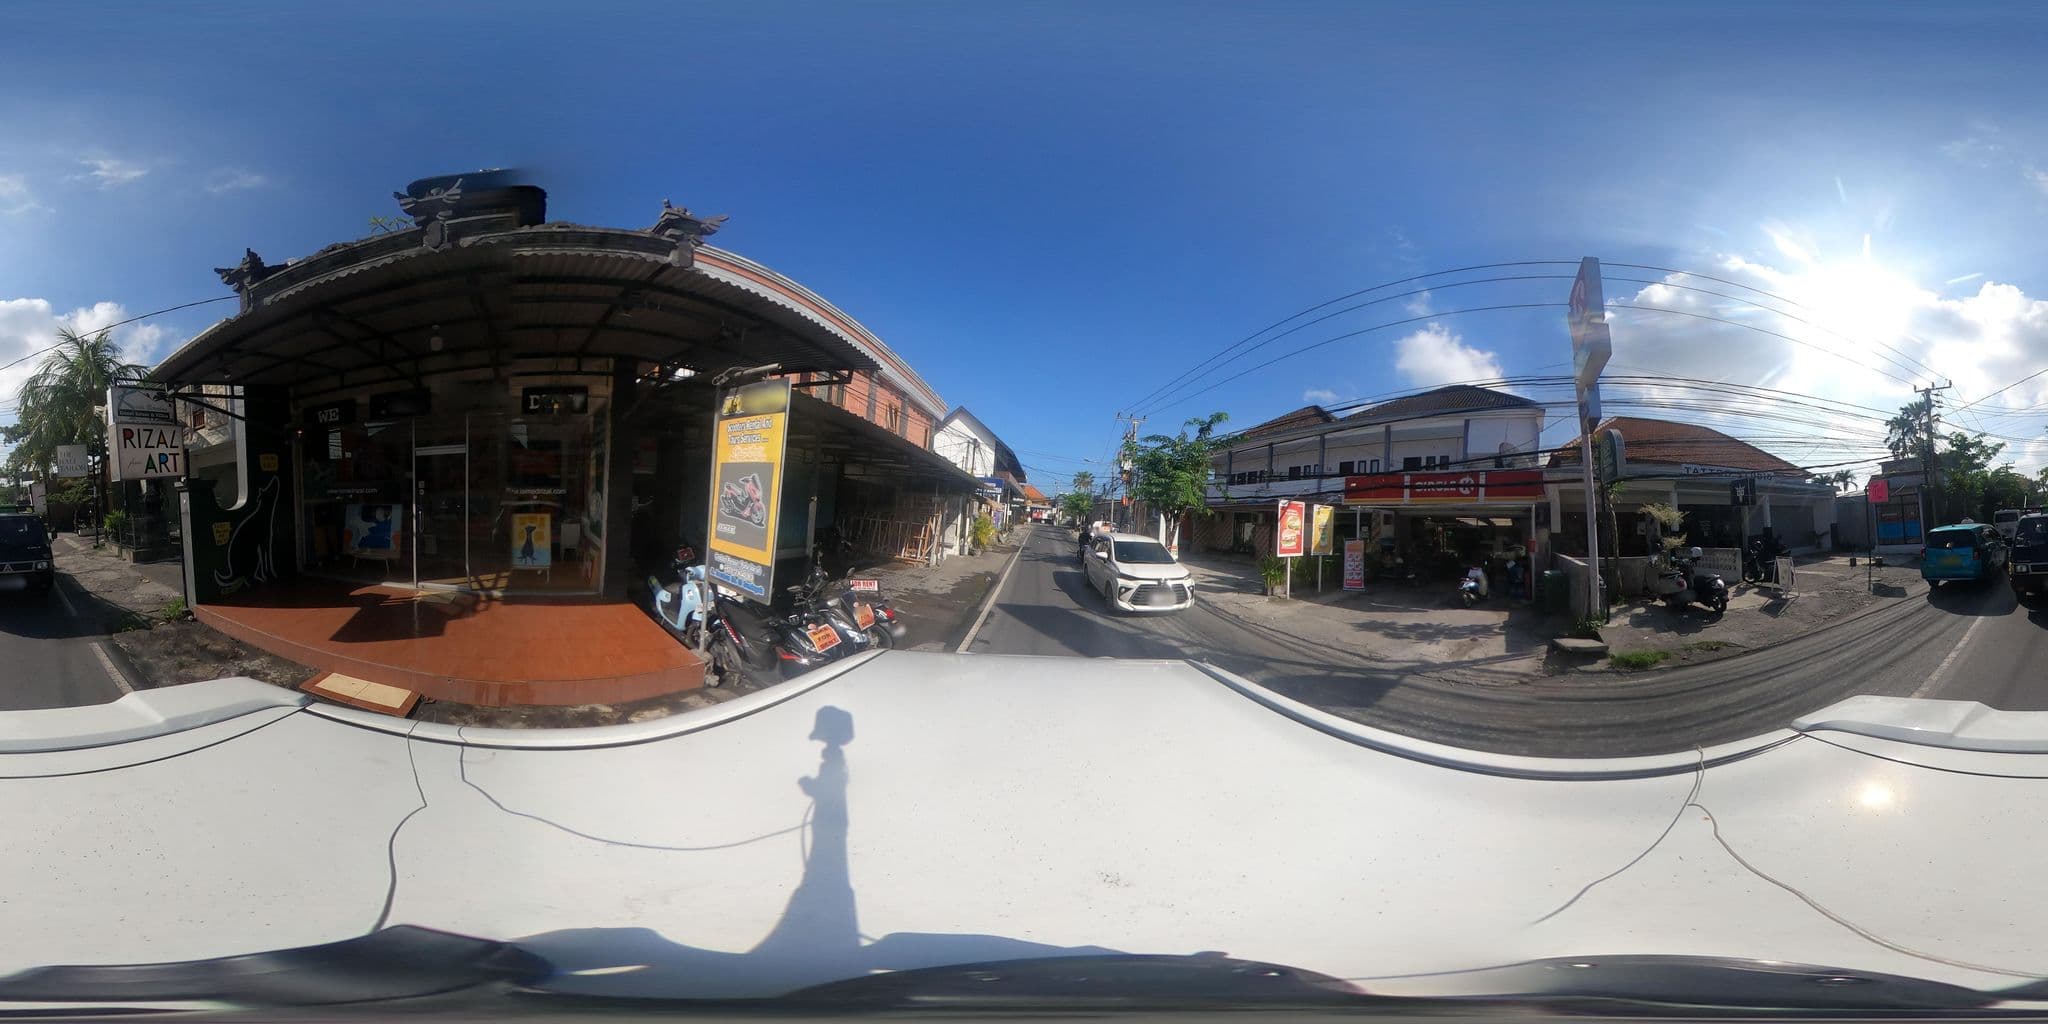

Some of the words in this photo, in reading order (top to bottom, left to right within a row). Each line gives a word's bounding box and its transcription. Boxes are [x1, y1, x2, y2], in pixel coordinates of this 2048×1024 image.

[318, 408, 339, 422] WE
[123, 428, 179, 448] RIZAL
[144, 453, 179, 473] ART
[1684, 467, 1731, 476] TATTO
[1414, 481, 1456, 492] CIRCLE
[863, 580, 876, 588] RENT
[818, 633, 830, 641] FOR
